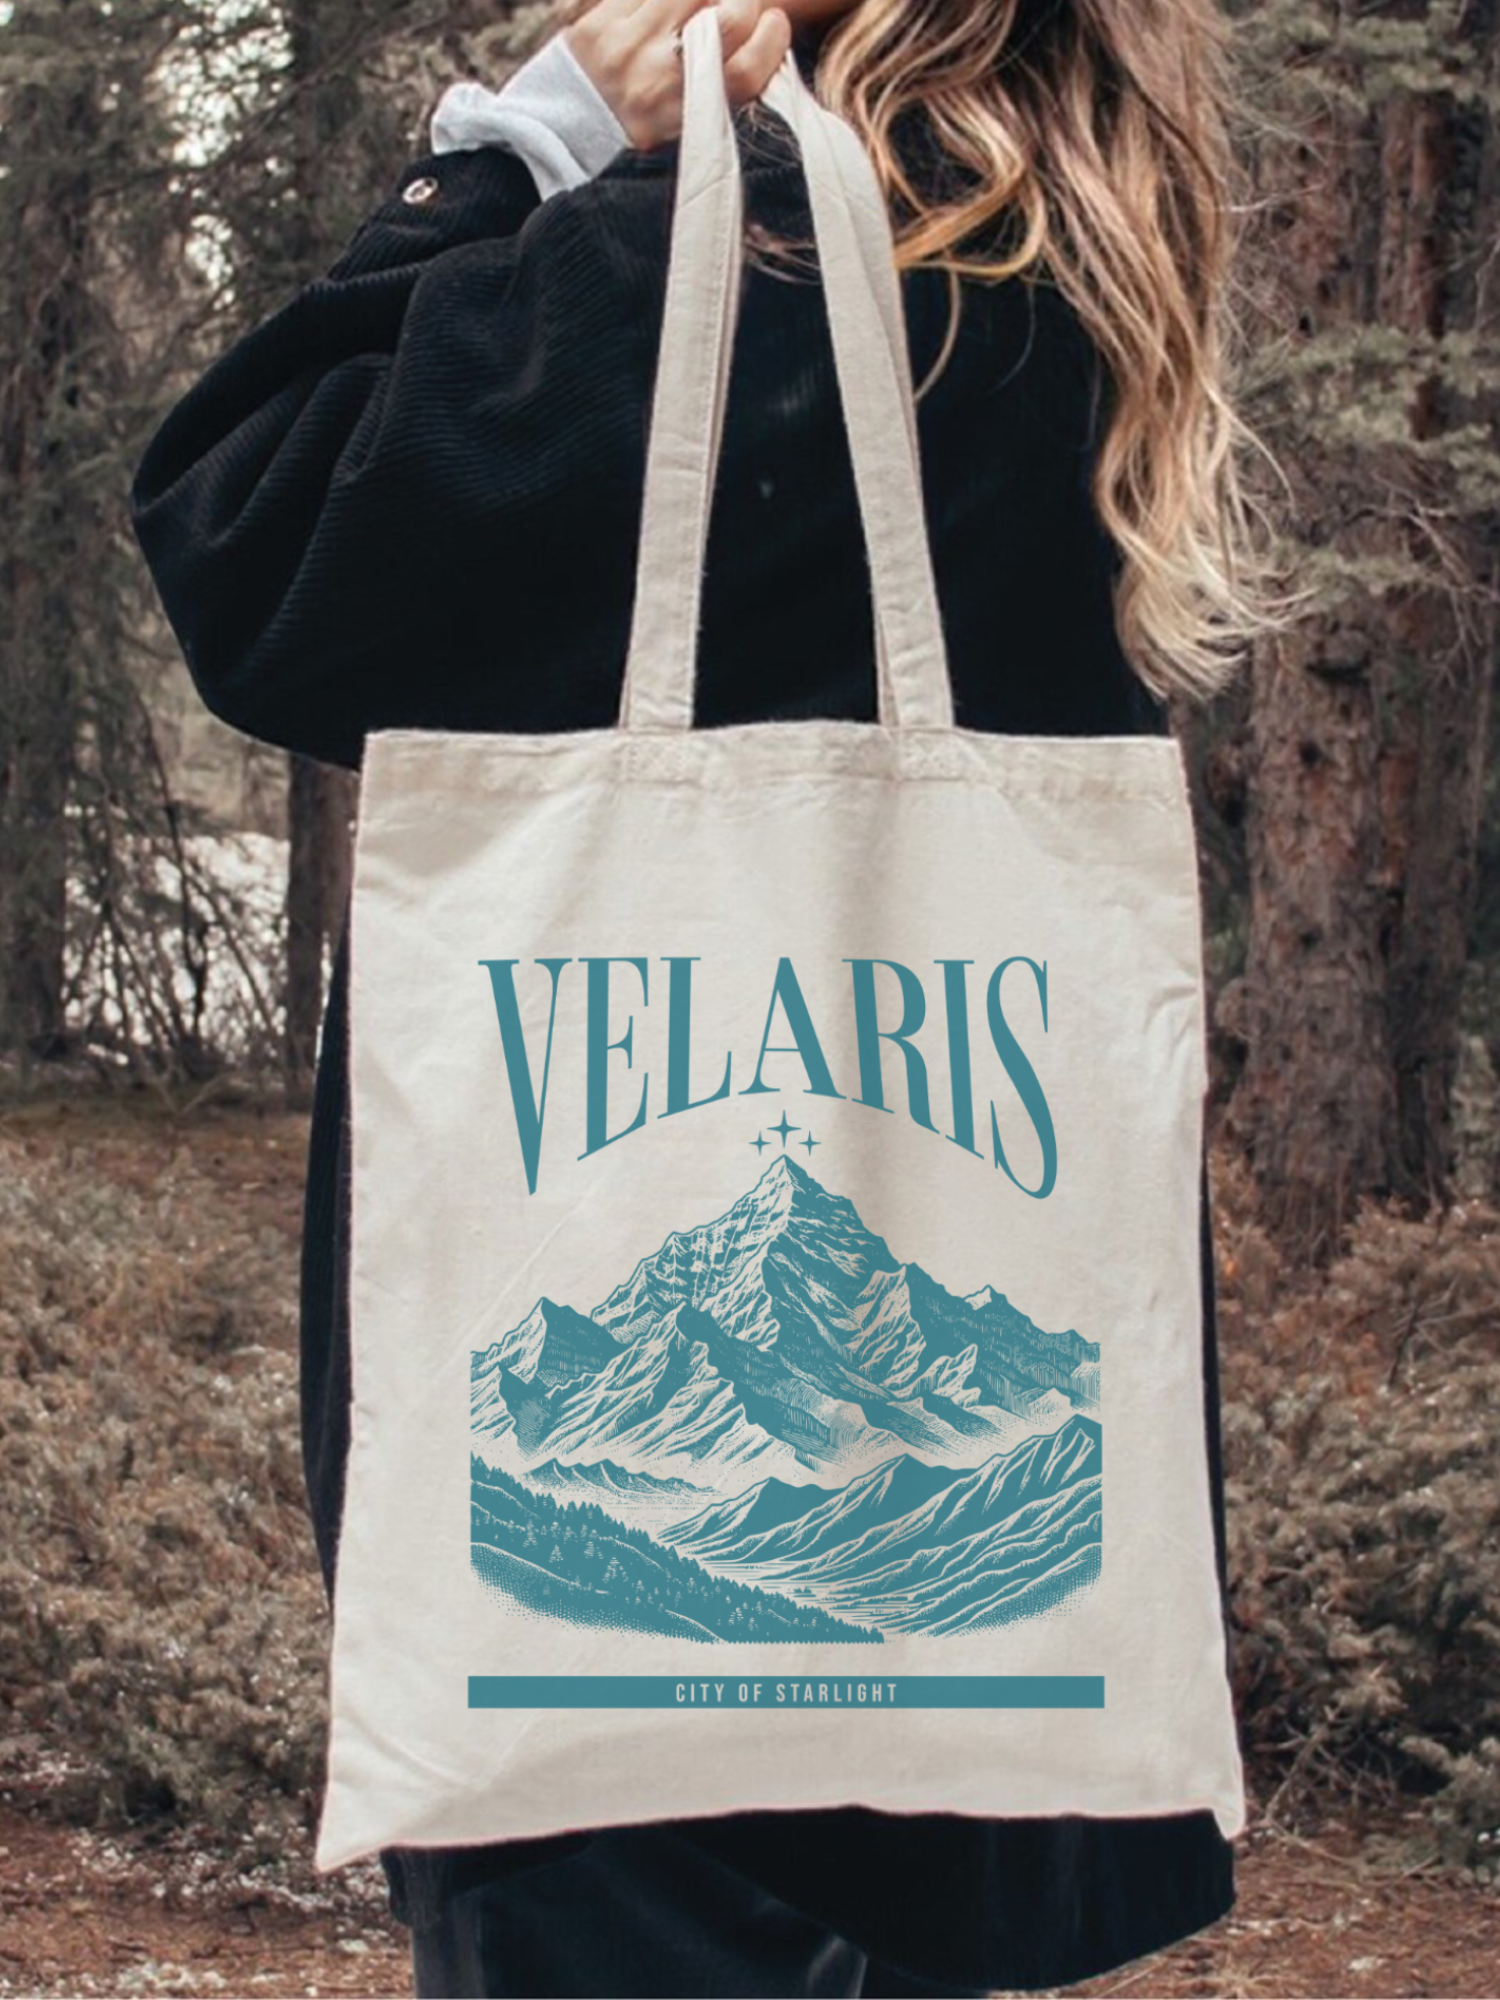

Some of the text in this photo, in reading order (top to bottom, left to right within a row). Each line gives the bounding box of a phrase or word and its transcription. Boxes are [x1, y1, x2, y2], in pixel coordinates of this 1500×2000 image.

[478, 956, 1058, 1200] VELARIS
[675, 1683, 898, 1703] CITY OF STARLIGHT
